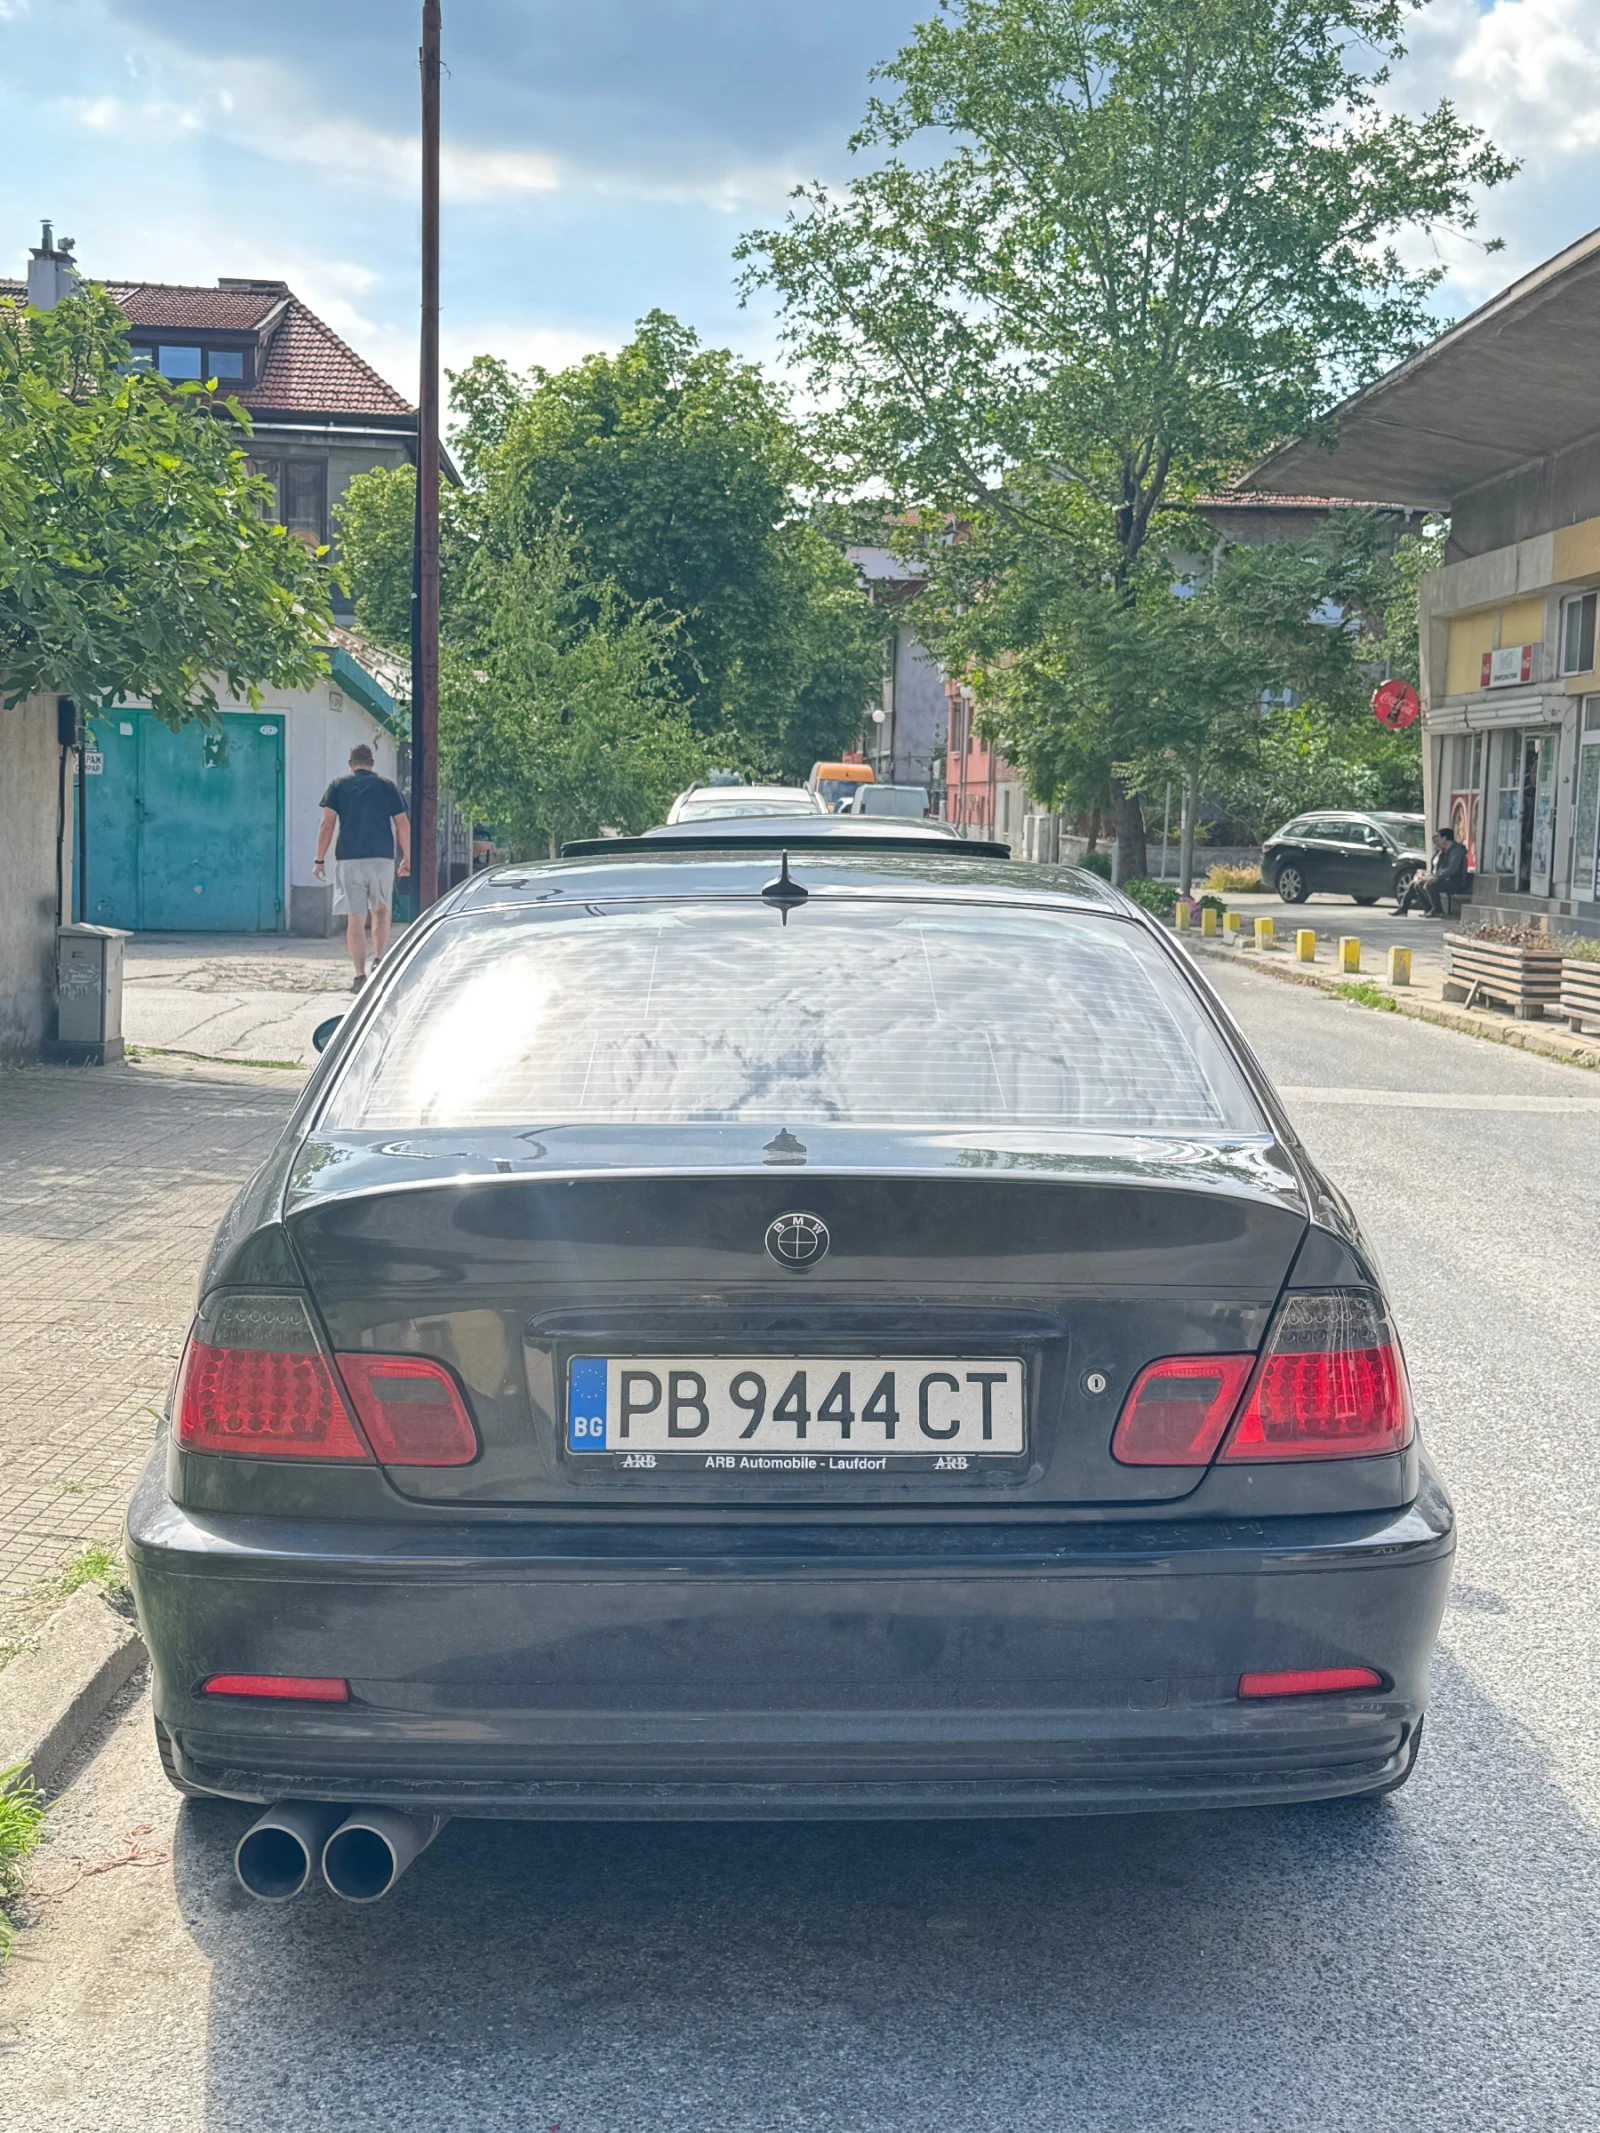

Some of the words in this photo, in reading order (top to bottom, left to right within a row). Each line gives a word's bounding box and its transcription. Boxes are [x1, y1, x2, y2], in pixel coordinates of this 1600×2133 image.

[773, 1216, 824, 1235] BMW
[619, 1370, 710, 1438] PB
[729, 1370, 900, 1440] 9444
[918, 1372, 1008, 1440] CT
[574, 1416, 603, 1437] BG
[620, 1454, 659, 1468] ARB
[704, 1456, 736, 1469] ARB
[739, 1456, 817, 1470] Automobile
[829, 1457, 887, 1470] Laufdorf
[932, 1456, 970, 1470] ARB
